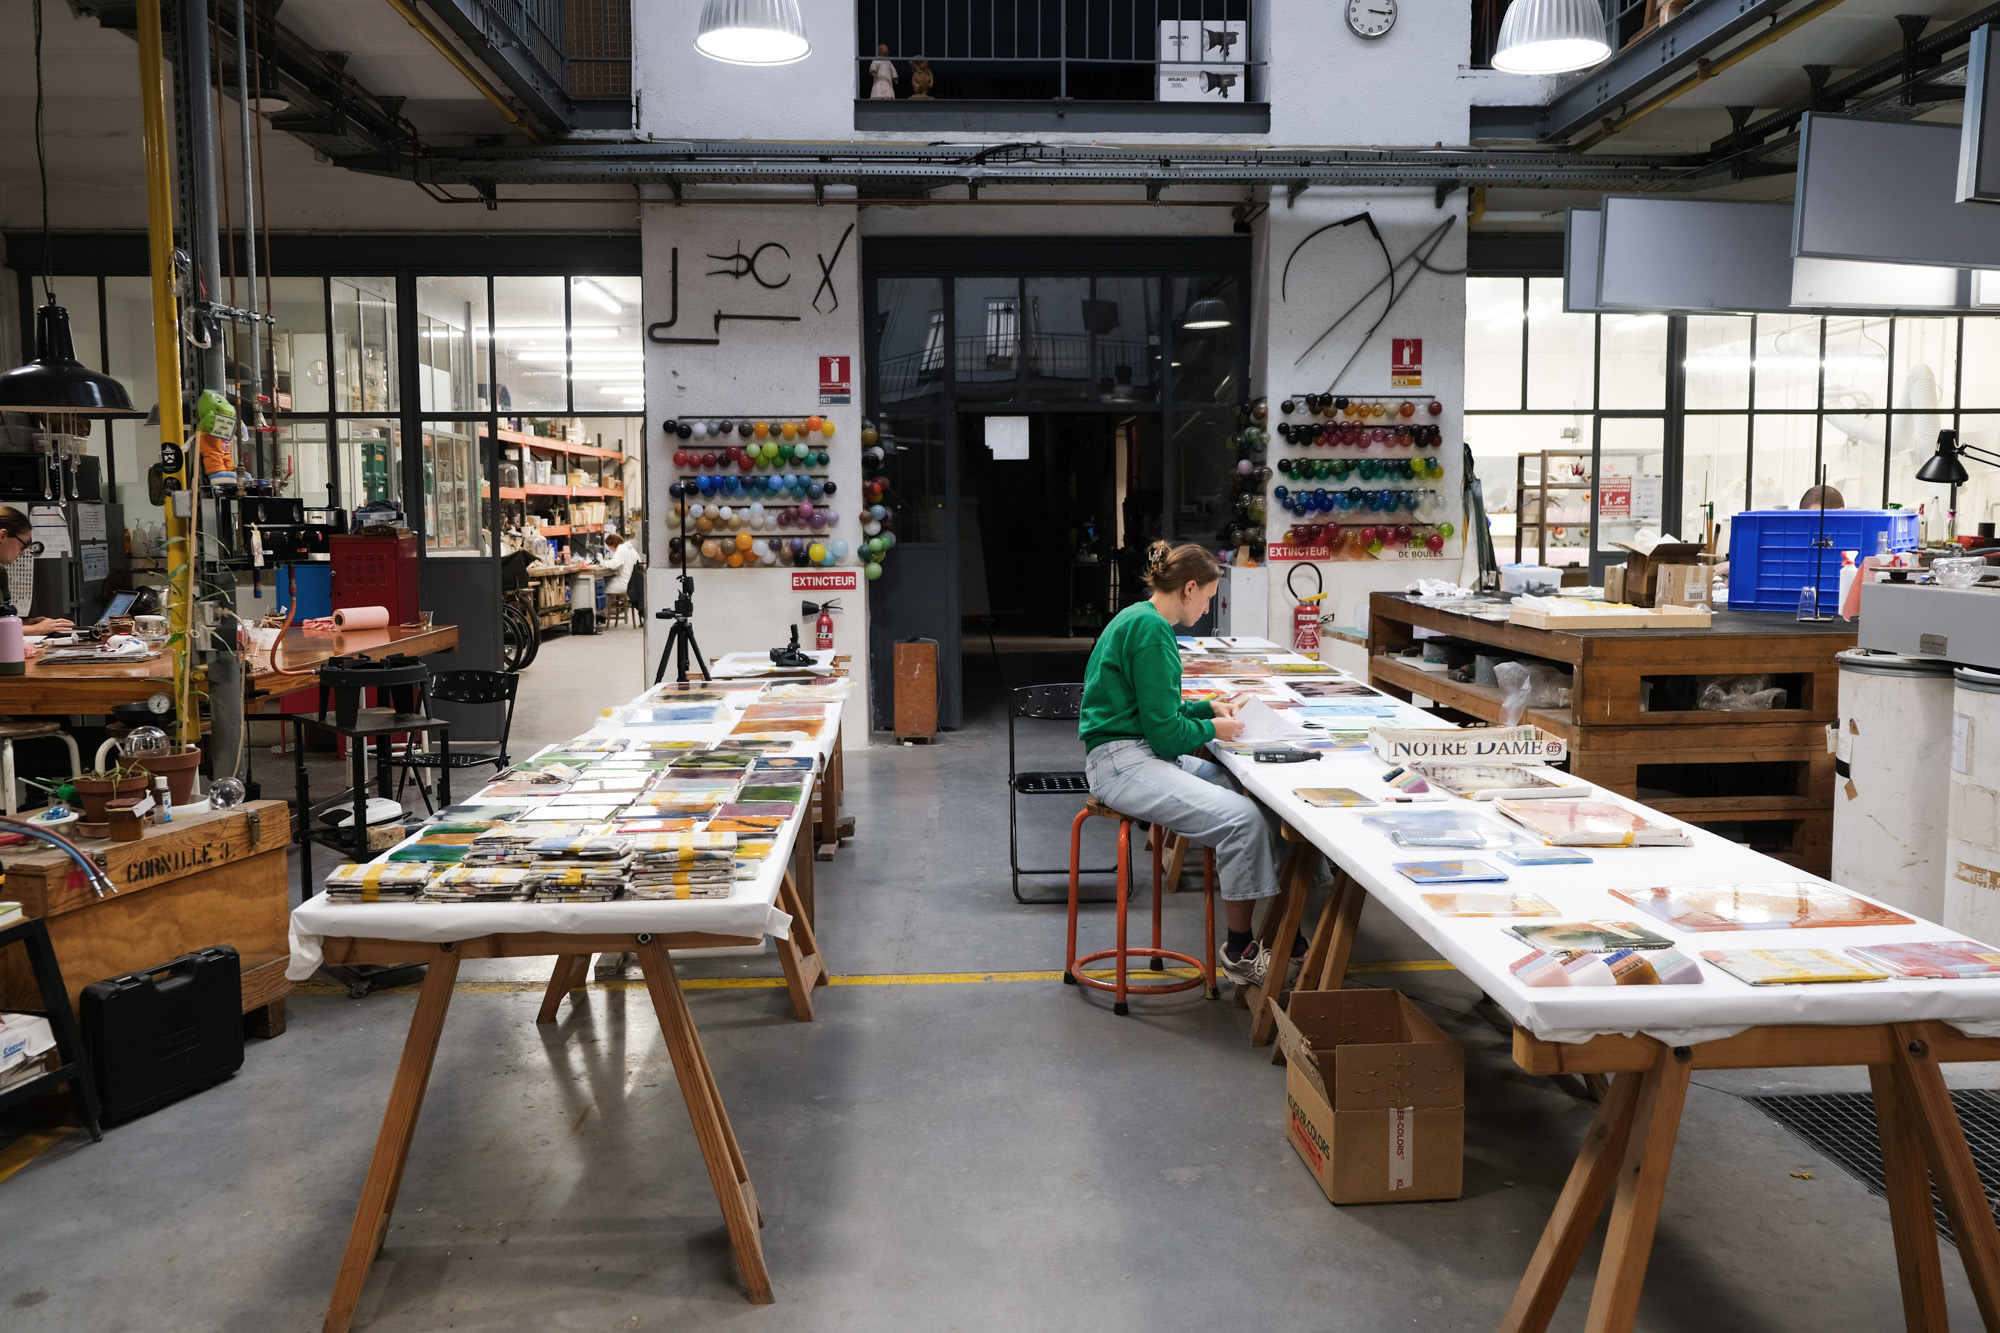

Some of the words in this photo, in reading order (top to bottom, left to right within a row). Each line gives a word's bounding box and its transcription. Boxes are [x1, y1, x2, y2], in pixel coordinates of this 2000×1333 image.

[1269, 546, 1329, 557] EXTINCTEUR
[1398, 550, 1409, 558] DE
[1411, 550, 1444, 558] BOULES
[792, 576, 855, 587] EXTINCTEUR
[1392, 742, 1467, 756] NOTRE
[1474, 741, 1543, 755] DAME
[127, 843, 212, 882] CORNILLE
